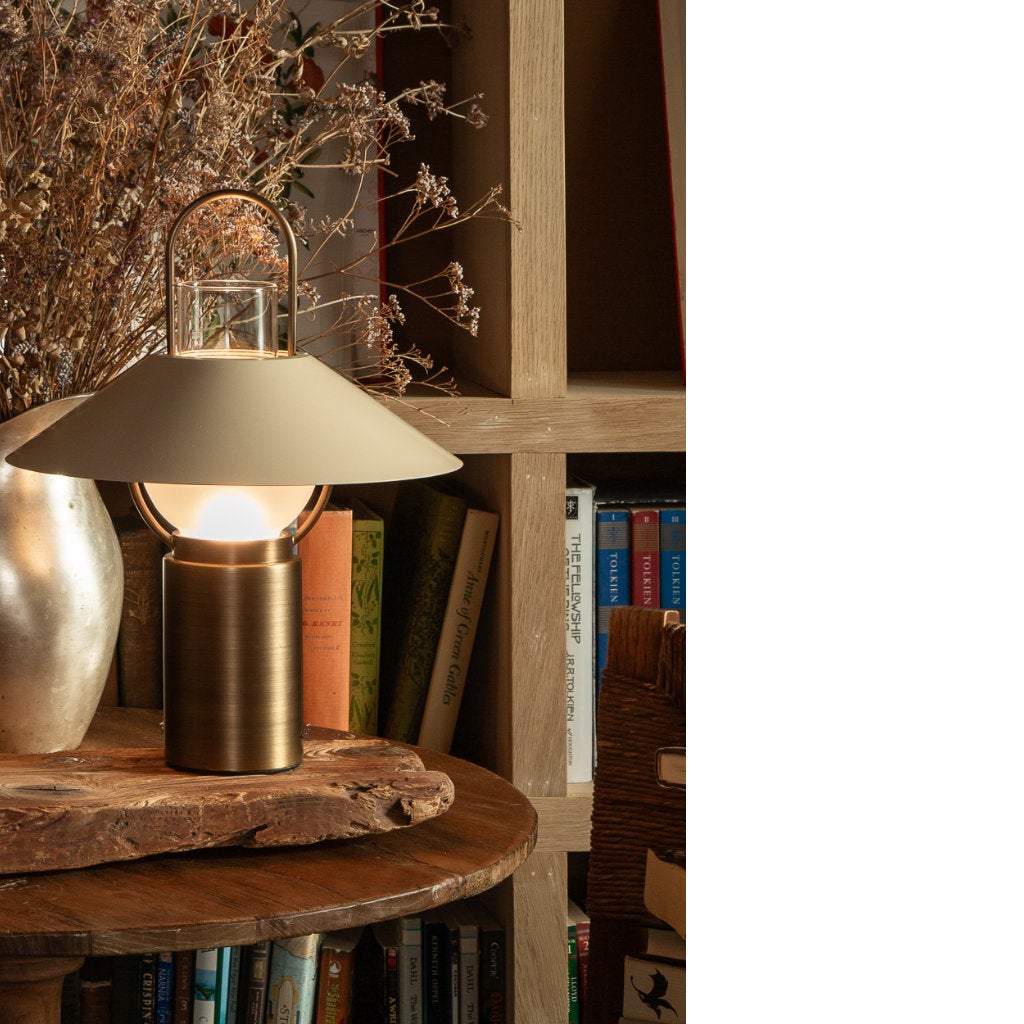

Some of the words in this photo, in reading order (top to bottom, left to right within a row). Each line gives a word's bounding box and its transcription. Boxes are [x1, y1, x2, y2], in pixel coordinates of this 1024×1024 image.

[571, 533, 582, 564] THE
[463, 570, 480, 605] Anne
[609, 552, 618, 603] TOLKIEN
[642, 554, 652, 605] TOLKIEN
[672, 554, 681, 605] TOLKIEN
[456, 607, 472, 624] of
[572, 565, 582, 645] FELLOWSHIP
[451, 623, 469, 660] Green
[443, 663, 461, 706] Gables
[410, 957, 418, 986] DAHL
[431, 935, 441, 976] KENNETH
[141, 972, 153, 1020] CRISPIN
[157, 968, 167, 1002] NARNIA
[466, 965, 474, 994] DAHL
